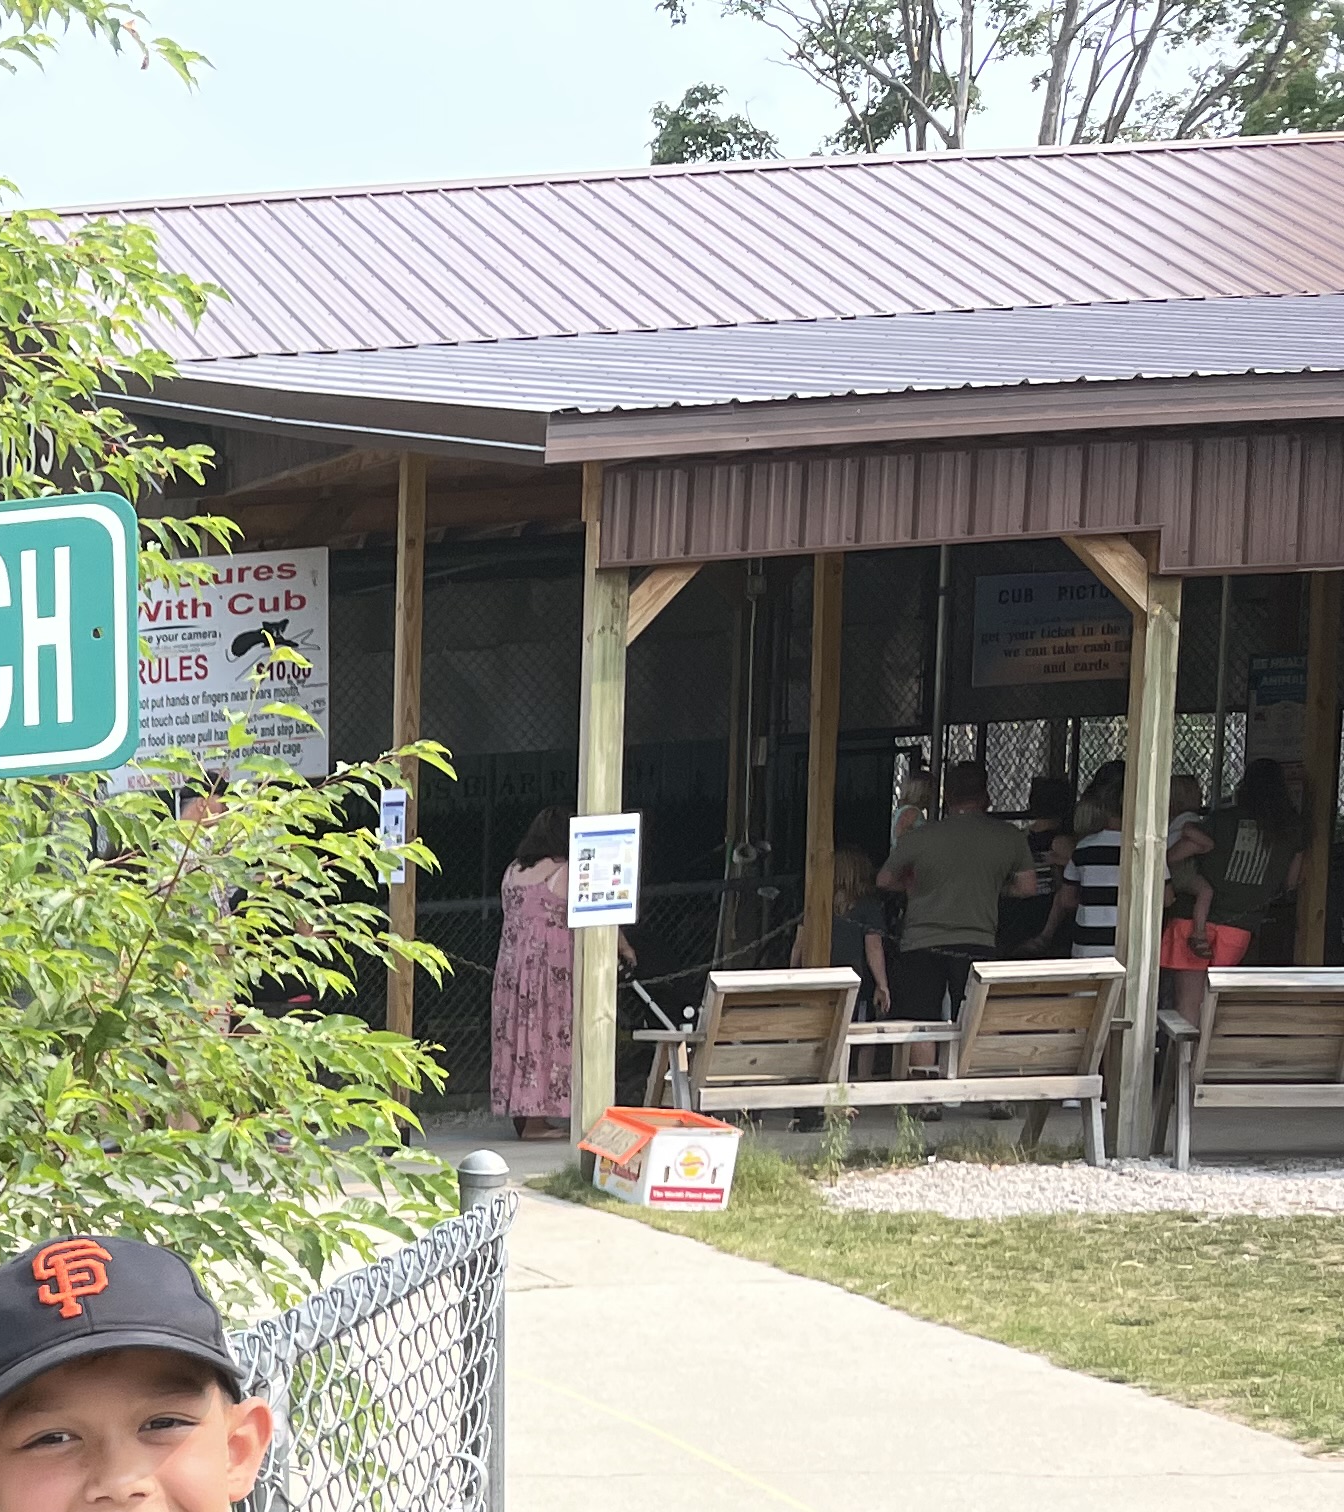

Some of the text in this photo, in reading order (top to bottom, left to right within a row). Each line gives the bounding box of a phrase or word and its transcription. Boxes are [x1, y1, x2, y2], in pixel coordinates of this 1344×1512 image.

[227, 590, 307, 615] Cub
[998, 588, 1033, 604] CUB
[155, 633, 178, 645] your
[981, 621, 1120, 644] get your ticket in the
[1003, 645, 1020, 658] we
[1025, 643, 1047, 656] can
[1052, 641, 1079, 655] take
[1083, 640, 1111, 653] cash
[1043, 659, 1109, 674] and cards
[151, 697, 164, 712] put
[166, 694, 189, 707] hands
[191, 695, 201, 705] or
[202, 691, 229, 708] fingers
[231, 691, 248, 701] near
[151, 713, 173, 728] touch
[175, 712, 190, 725] cub
[192, 711, 209, 724] until
[148, 733, 166, 747] food
[168, 733, 175, 745] is
[176, 733, 196, 746] gone
[198, 729, 212, 745] pull
[261, 725, 275, 736] and
[277, 724, 293, 740] step
[273, 741, 281, 755] of
[32, 1239, 113, 1319] SF
